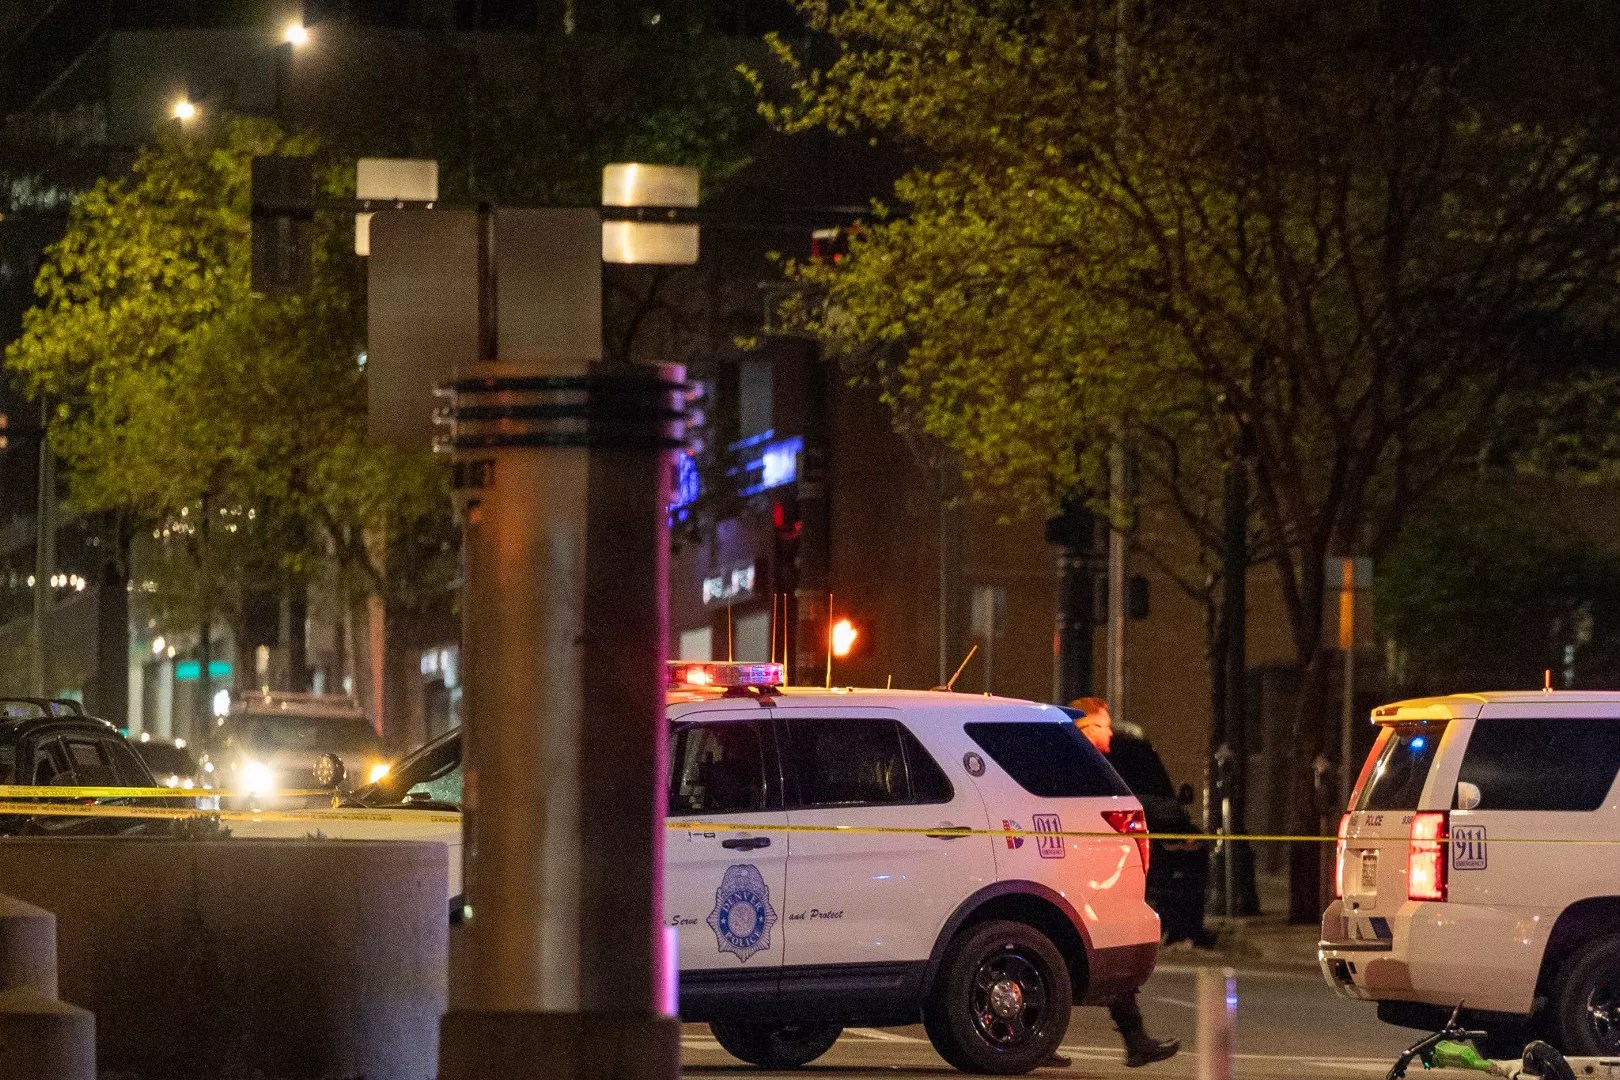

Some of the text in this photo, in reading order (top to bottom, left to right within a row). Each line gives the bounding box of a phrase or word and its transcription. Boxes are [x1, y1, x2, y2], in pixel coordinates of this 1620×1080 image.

[1037, 818, 1062, 849] 911
[1456, 829, 1484, 860] 911
[722, 891, 763, 912] DENVER
[671, 915, 698, 926] Serve
[788, 908, 844, 921] and Protect
[725, 930, 761, 948] POLICE
